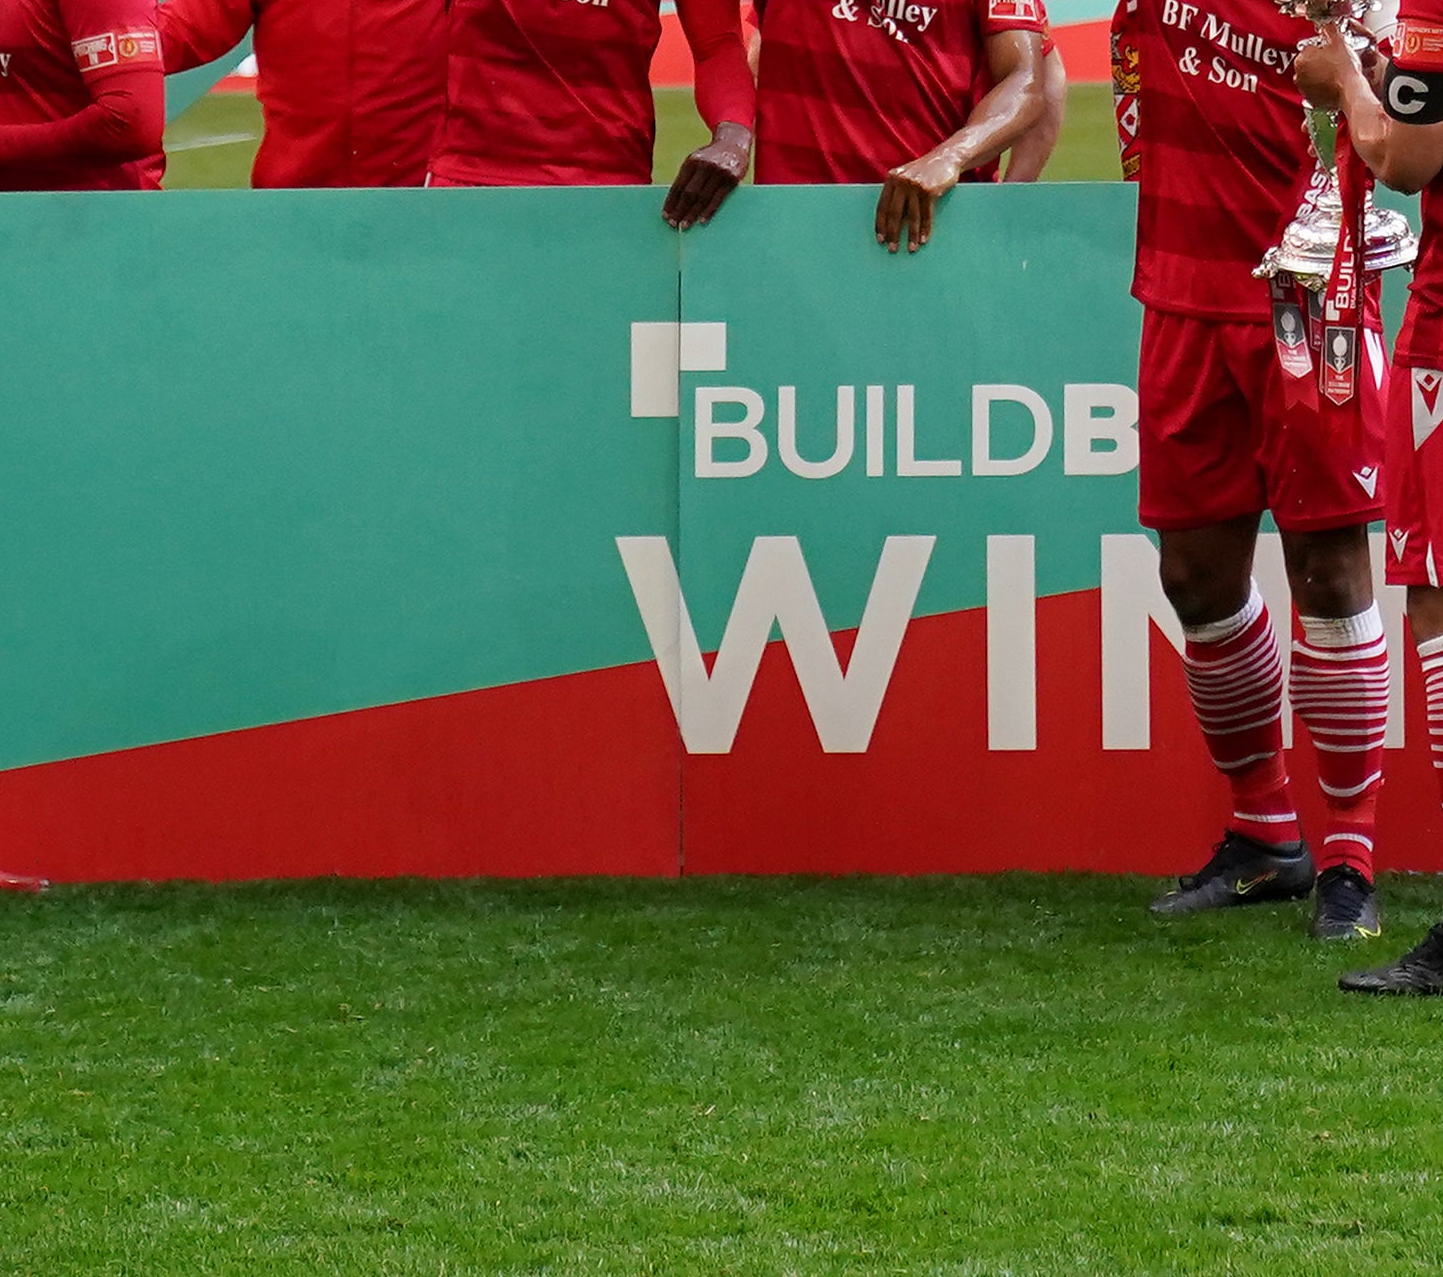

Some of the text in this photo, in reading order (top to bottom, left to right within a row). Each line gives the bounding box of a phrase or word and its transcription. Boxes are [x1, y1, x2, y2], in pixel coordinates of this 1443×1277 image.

[1178, 46, 1260, 94] & Son
[1199, 12, 1298, 76] Mulley
[1387, 74, 1430, 116] C
[694, 380, 1140, 481] BUILDB
